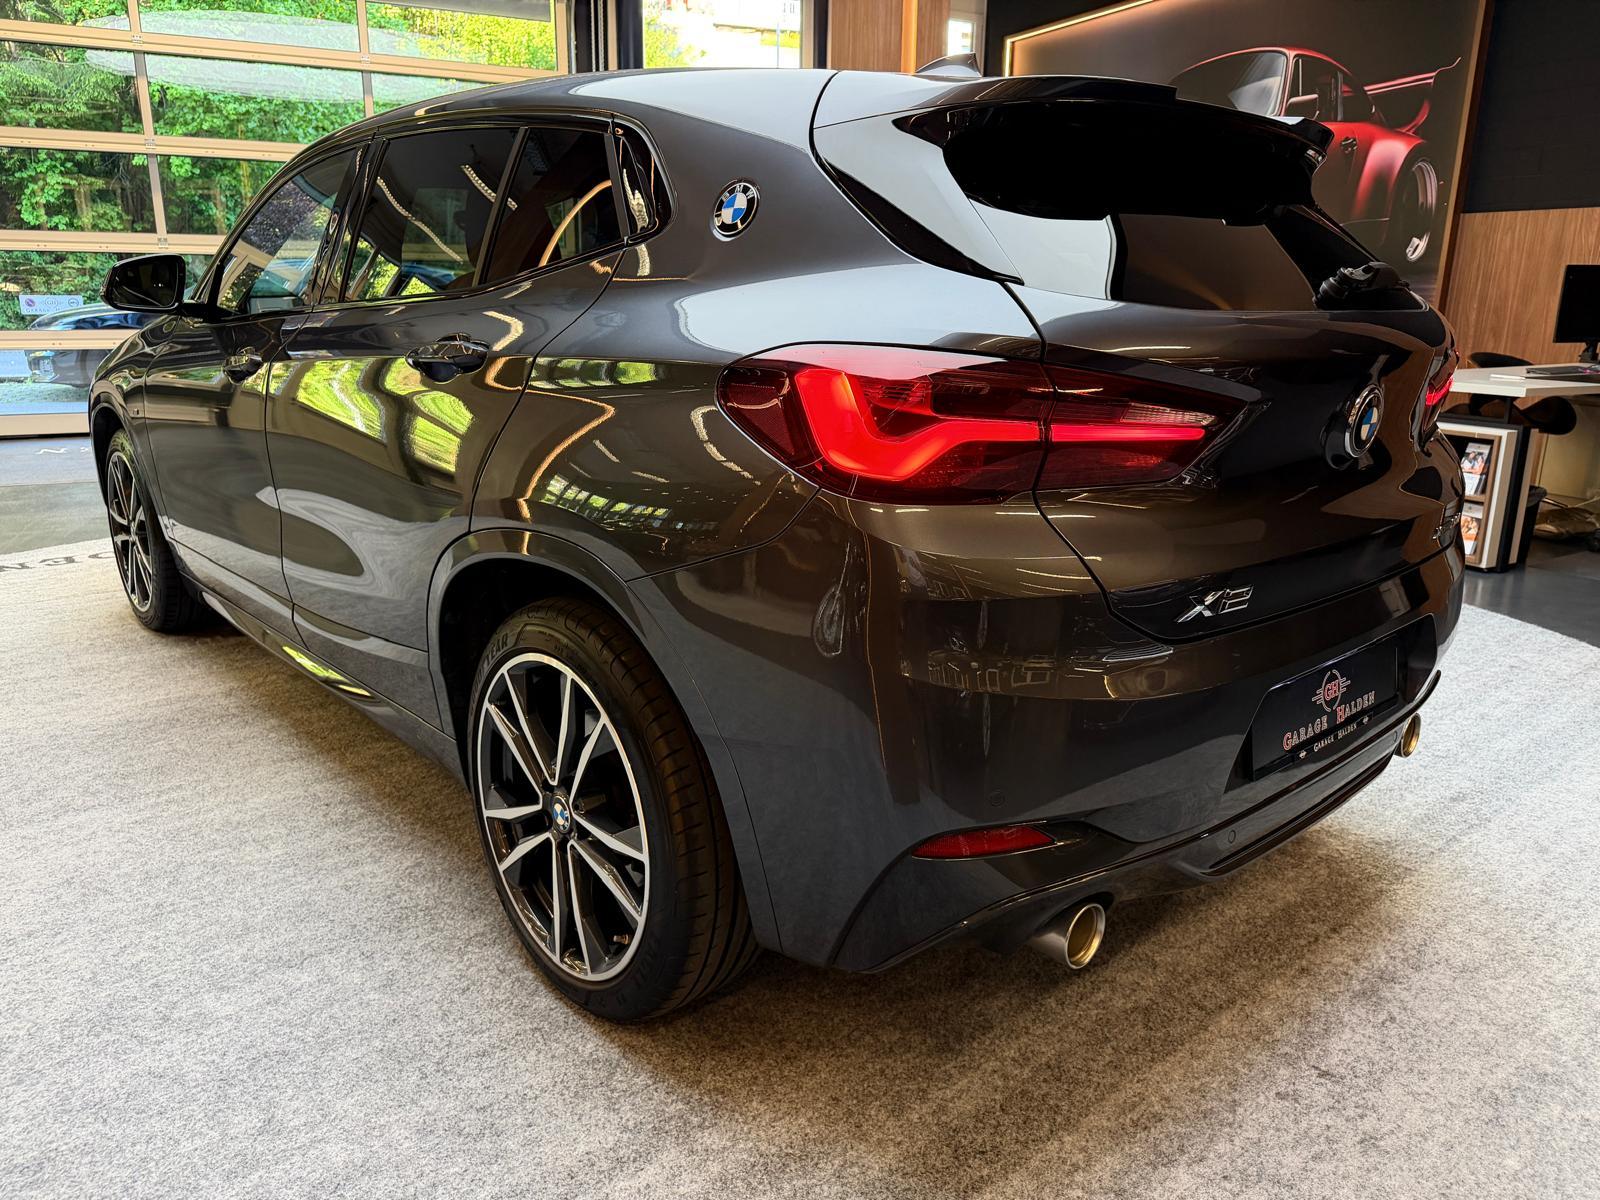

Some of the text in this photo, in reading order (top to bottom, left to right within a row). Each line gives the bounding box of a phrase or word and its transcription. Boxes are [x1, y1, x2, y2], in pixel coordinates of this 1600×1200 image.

[1177, 584, 1254, 624] X2
[1324, 679, 1340, 701] GH
[1282, 690, 1376, 751] GARAGE HALDEN
[1313, 734, 1335, 752] GARAGE
